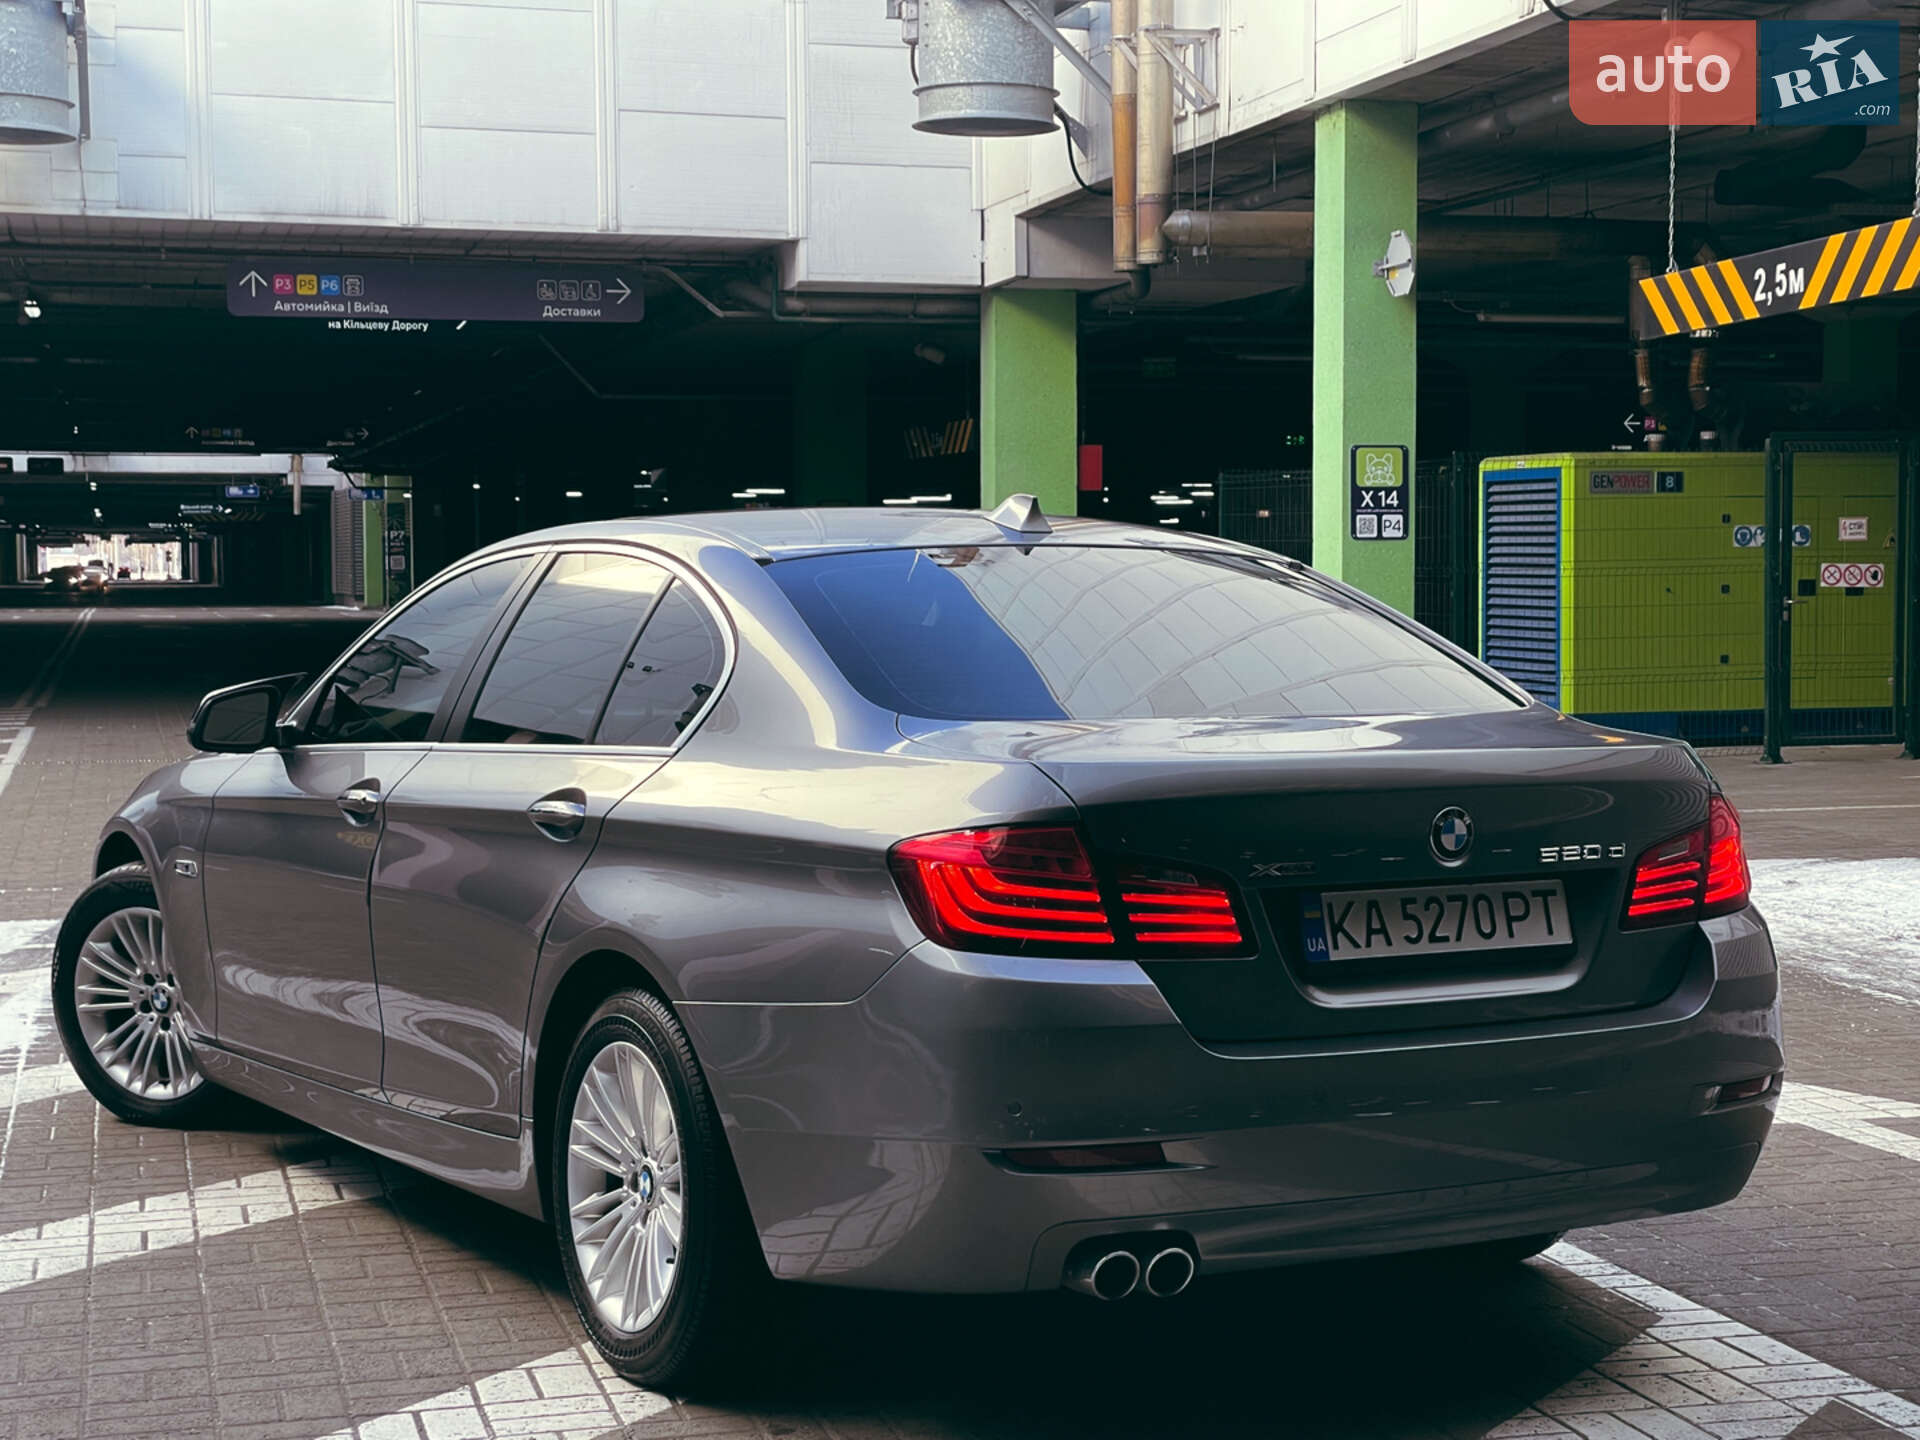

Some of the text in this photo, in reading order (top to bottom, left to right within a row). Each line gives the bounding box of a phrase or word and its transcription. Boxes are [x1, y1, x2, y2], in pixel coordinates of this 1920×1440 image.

[275, 278, 339, 292] P3 P5 P6
[274, 300, 345, 313] Автомийка
[353, 302, 389, 315] Виїзд
[542, 305, 601, 318] Доставки
[328, 321, 342, 330] на
[391, 320, 429, 333] Дорогу
[1377, 490, 1399, 507] 14
[1383, 519, 1402, 533] P4
[1326, 888, 1557, 951] KA 5270 PT
[1307, 938, 1326, 953] UA
